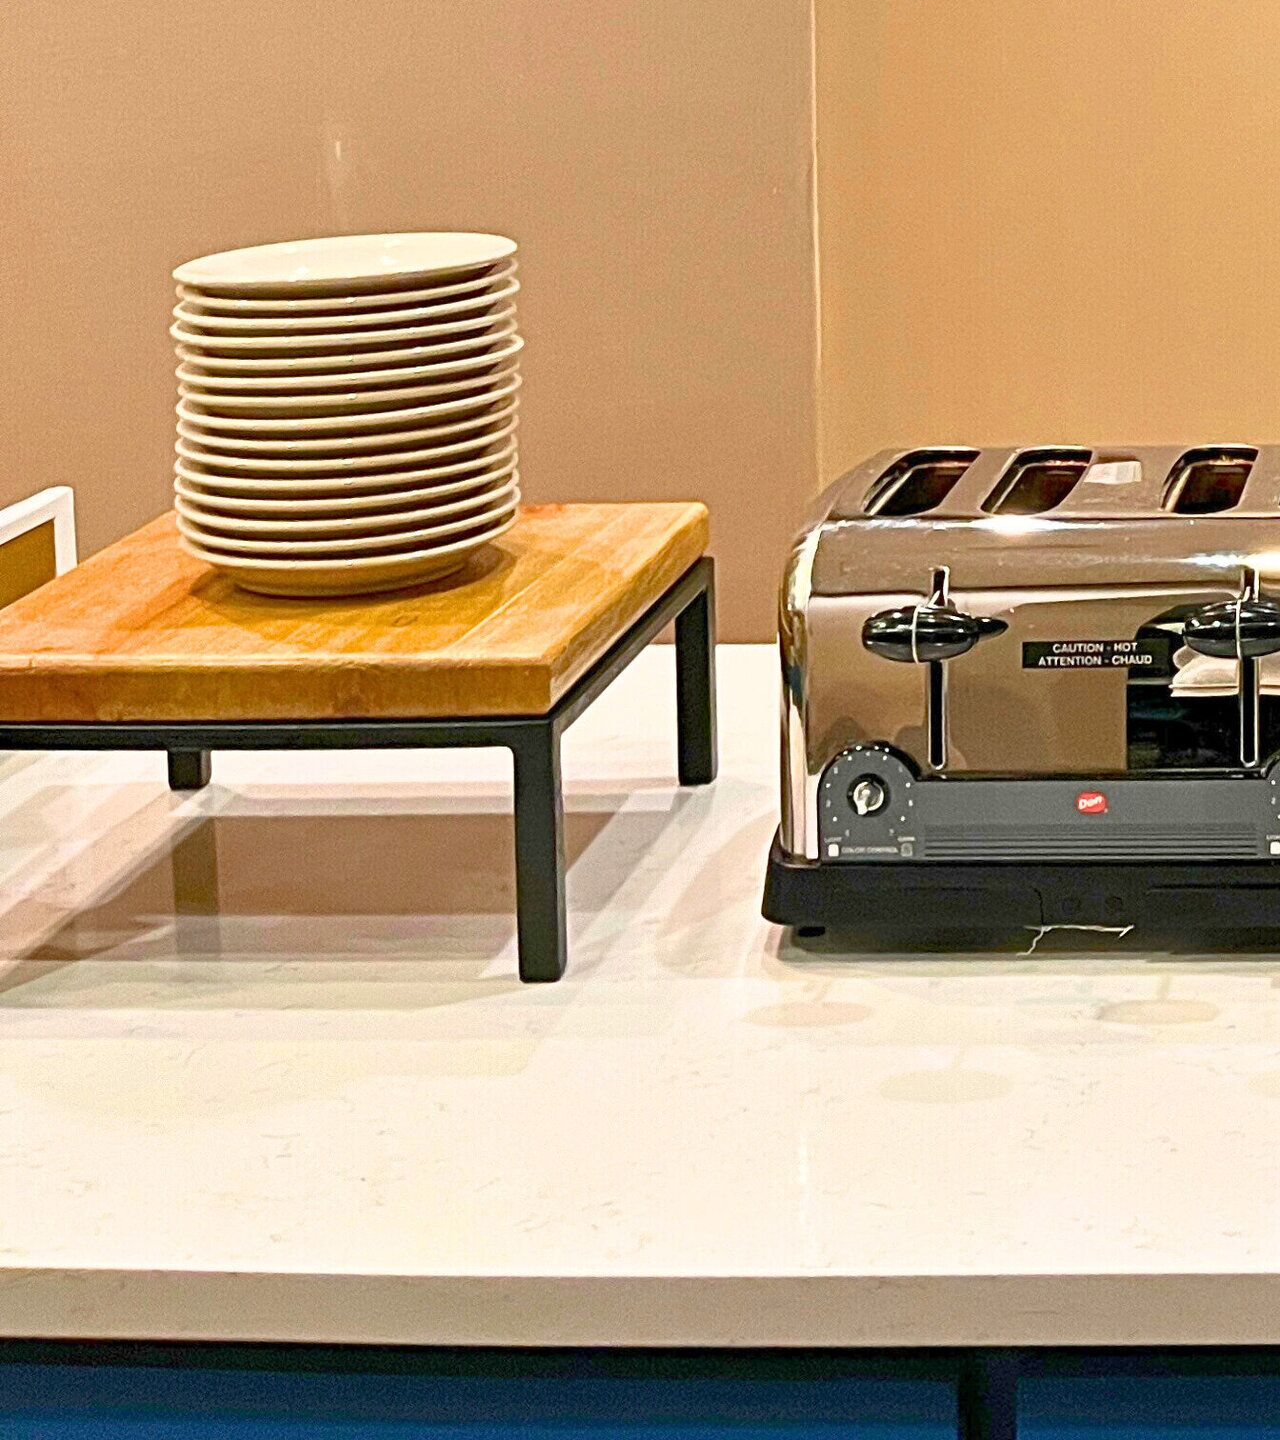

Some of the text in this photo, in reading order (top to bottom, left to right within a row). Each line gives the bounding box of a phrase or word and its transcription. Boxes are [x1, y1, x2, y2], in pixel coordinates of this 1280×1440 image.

[1052, 643, 1104, 654] CAUTION
[1113, 642, 1138, 653] HOT
[1038, 656, 1102, 667] ATTENTION
[1111, 654, 1153, 665] CHAUD
